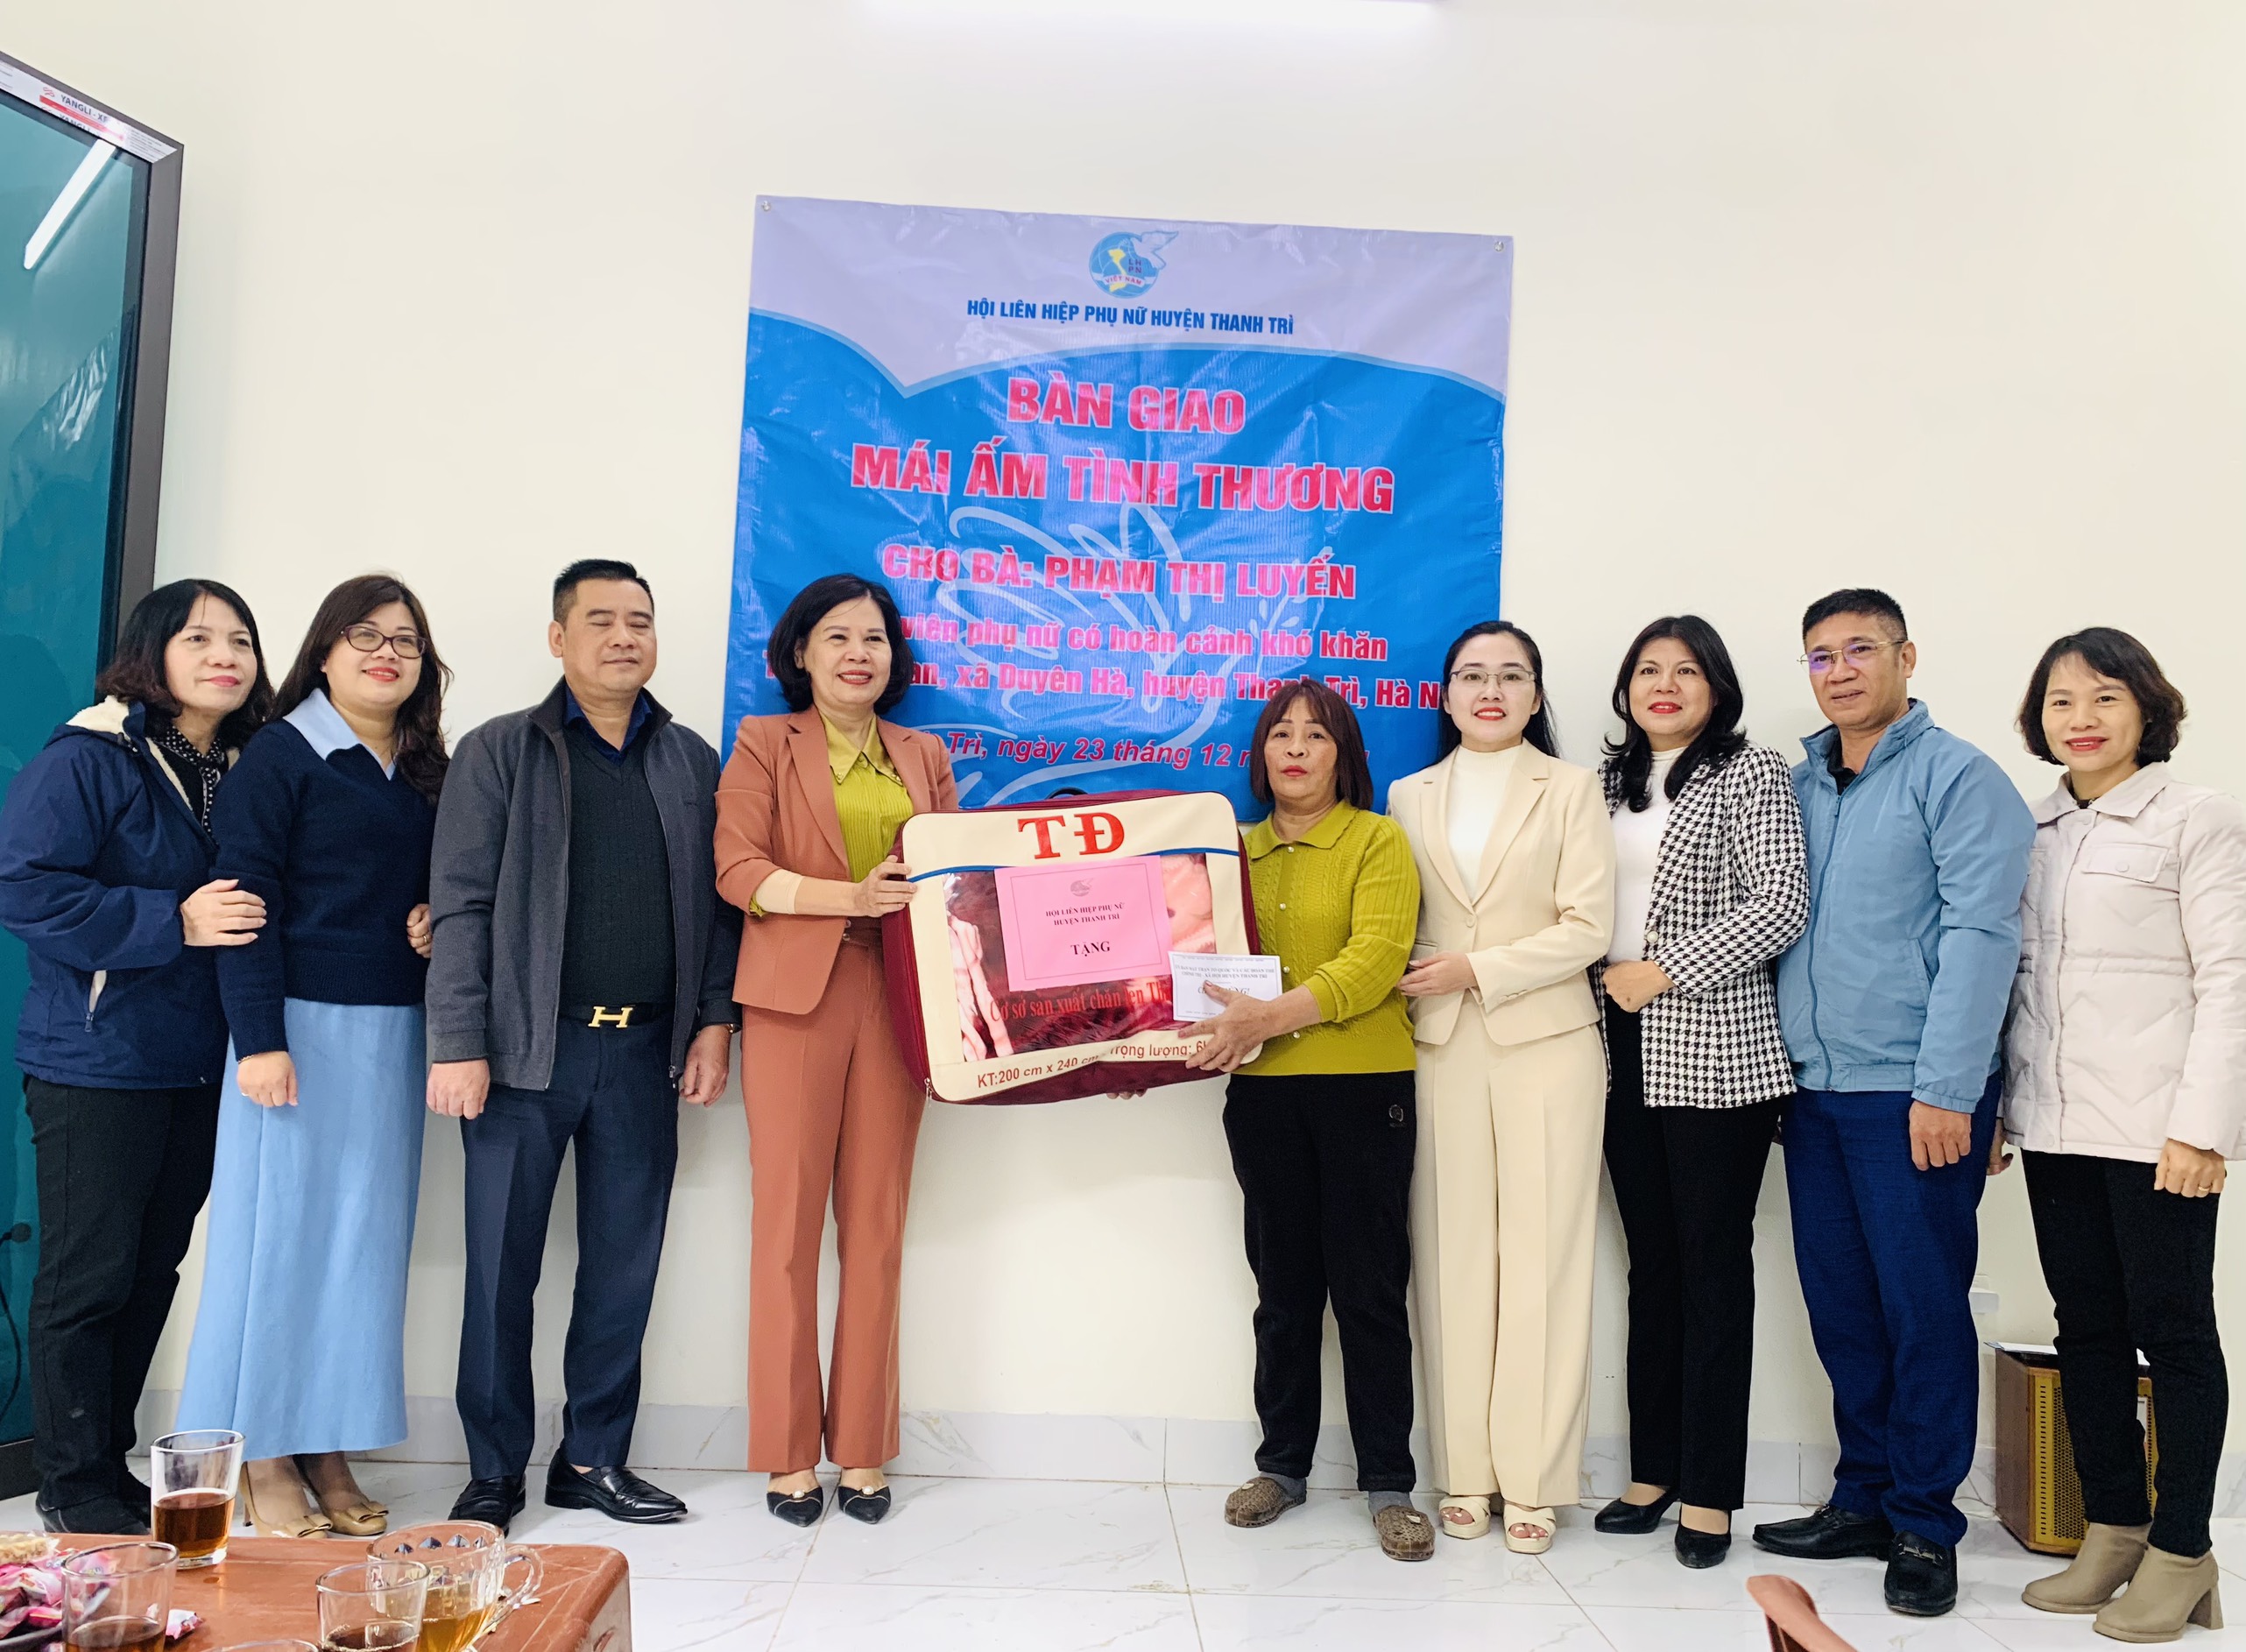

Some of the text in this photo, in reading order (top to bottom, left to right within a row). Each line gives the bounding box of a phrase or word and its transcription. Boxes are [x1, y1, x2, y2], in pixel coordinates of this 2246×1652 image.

[60, 94, 91, 115] YANGLI
[967, 298, 1294, 335] HỘI LIÊN HIỆP PHỤ NỮ HUYỆN THANH TRÌ
[1007, 371, 1246, 434] BÀN GIAO
[851, 435, 1395, 515] MÁI ẤM TÌNH THƯƠNG
[882, 543, 1356, 604] CHO BÀ: PHẠM THỊ LUYẾN
[901, 611, 1388, 661] viên phụ nữ có hoàn cảnh khó khăn
[954, 661, 990, 689] xã
[998, 662, 1083, 695] Duyên
[1091, 667, 1134, 698] Hà,
[1143, 670, 1226, 704] huyện
[1375, 678, 1411, 709] Hà
[947, 731, 987, 760] Trì,
[997, 734, 1066, 764] ngày
[1071, 738, 1105, 761] 23
[1113, 738, 1192, 771] tháng
[1200, 742, 1232, 767] 12
[1070, 941, 1111, 957] TẶNG
[1090, 988, 1120, 1009] chăn
[978, 1068, 1020, 1088] KT:200
[1023, 1067, 1042, 1077] cm
[1046, 1064, 1053, 1073] x
[1057, 1057, 1077, 1071] 240
